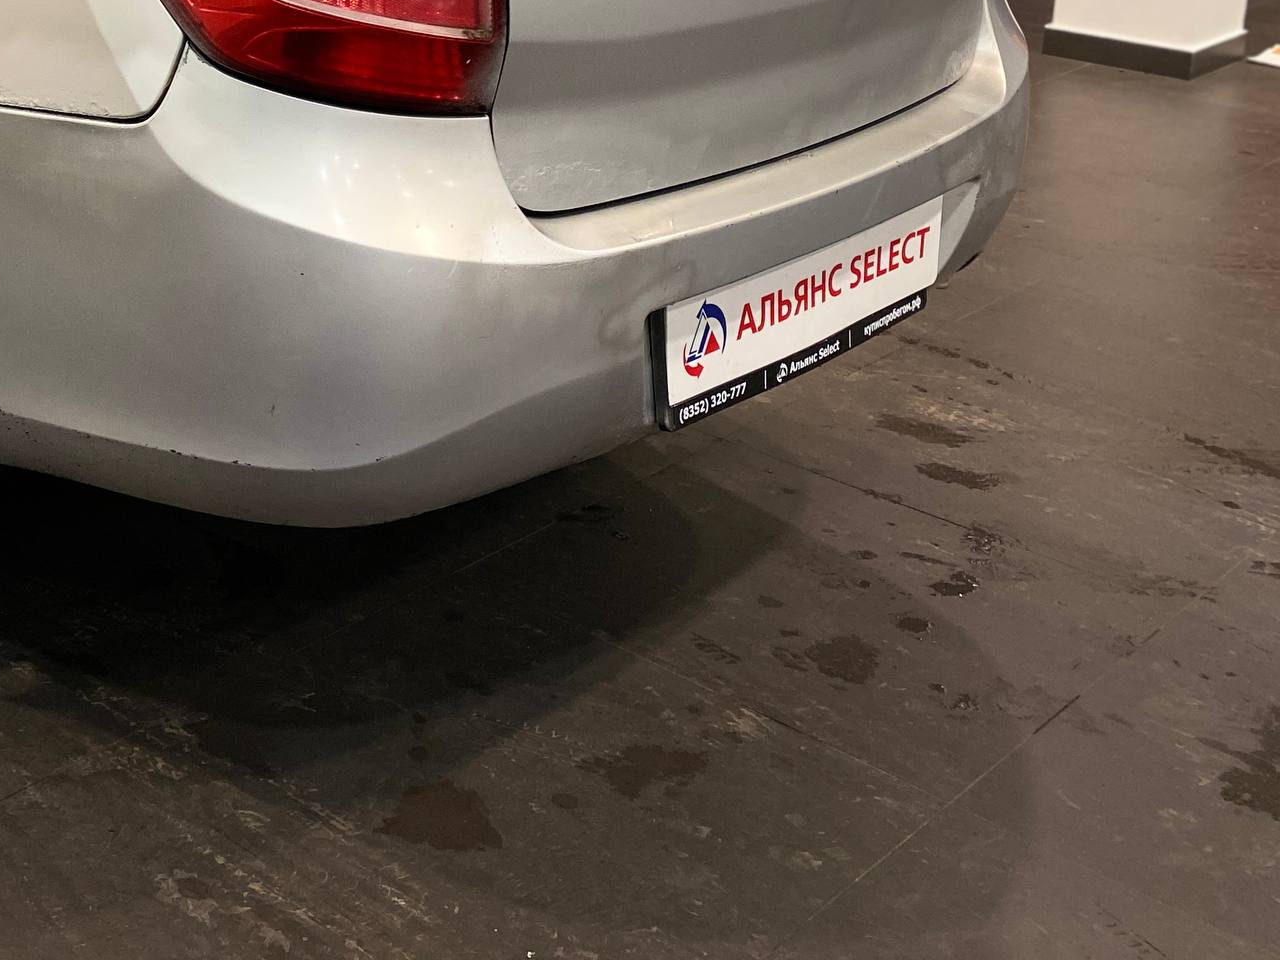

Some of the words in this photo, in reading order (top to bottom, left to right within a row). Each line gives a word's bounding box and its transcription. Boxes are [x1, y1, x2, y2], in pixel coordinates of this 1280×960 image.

[736, 263, 843, 340] АЛЬЯНС
[850, 226, 931, 289] SELECT
[679, 398, 709, 425] (8352)
[711, 381, 747, 408] 320-777
[789, 352, 818, 374] Альянс
[818, 339, 840, 359] Select
